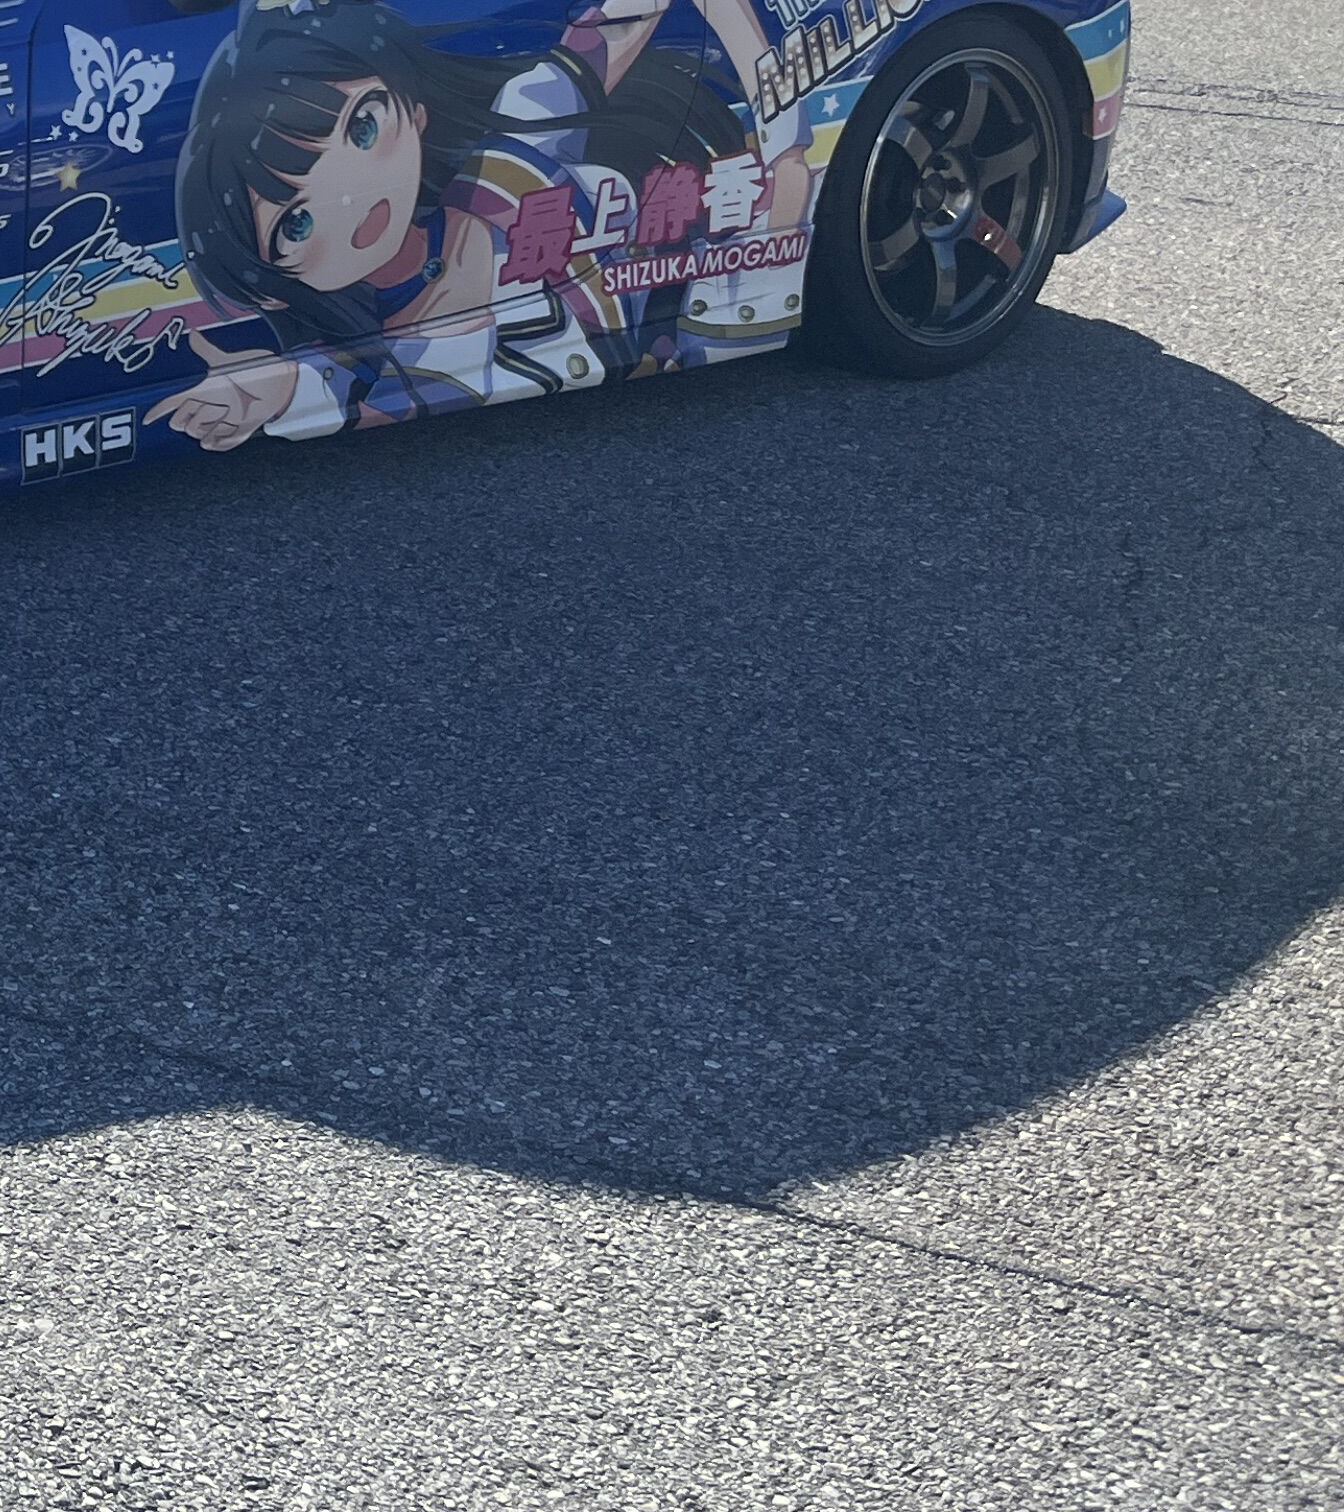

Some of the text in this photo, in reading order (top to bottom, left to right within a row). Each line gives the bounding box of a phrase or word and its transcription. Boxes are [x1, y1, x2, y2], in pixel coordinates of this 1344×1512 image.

[503, 152, 768, 286] 最上静香
[603, 234, 807, 292] SHIZUKA MOGAMI
[24, 414, 131, 468] HKS
